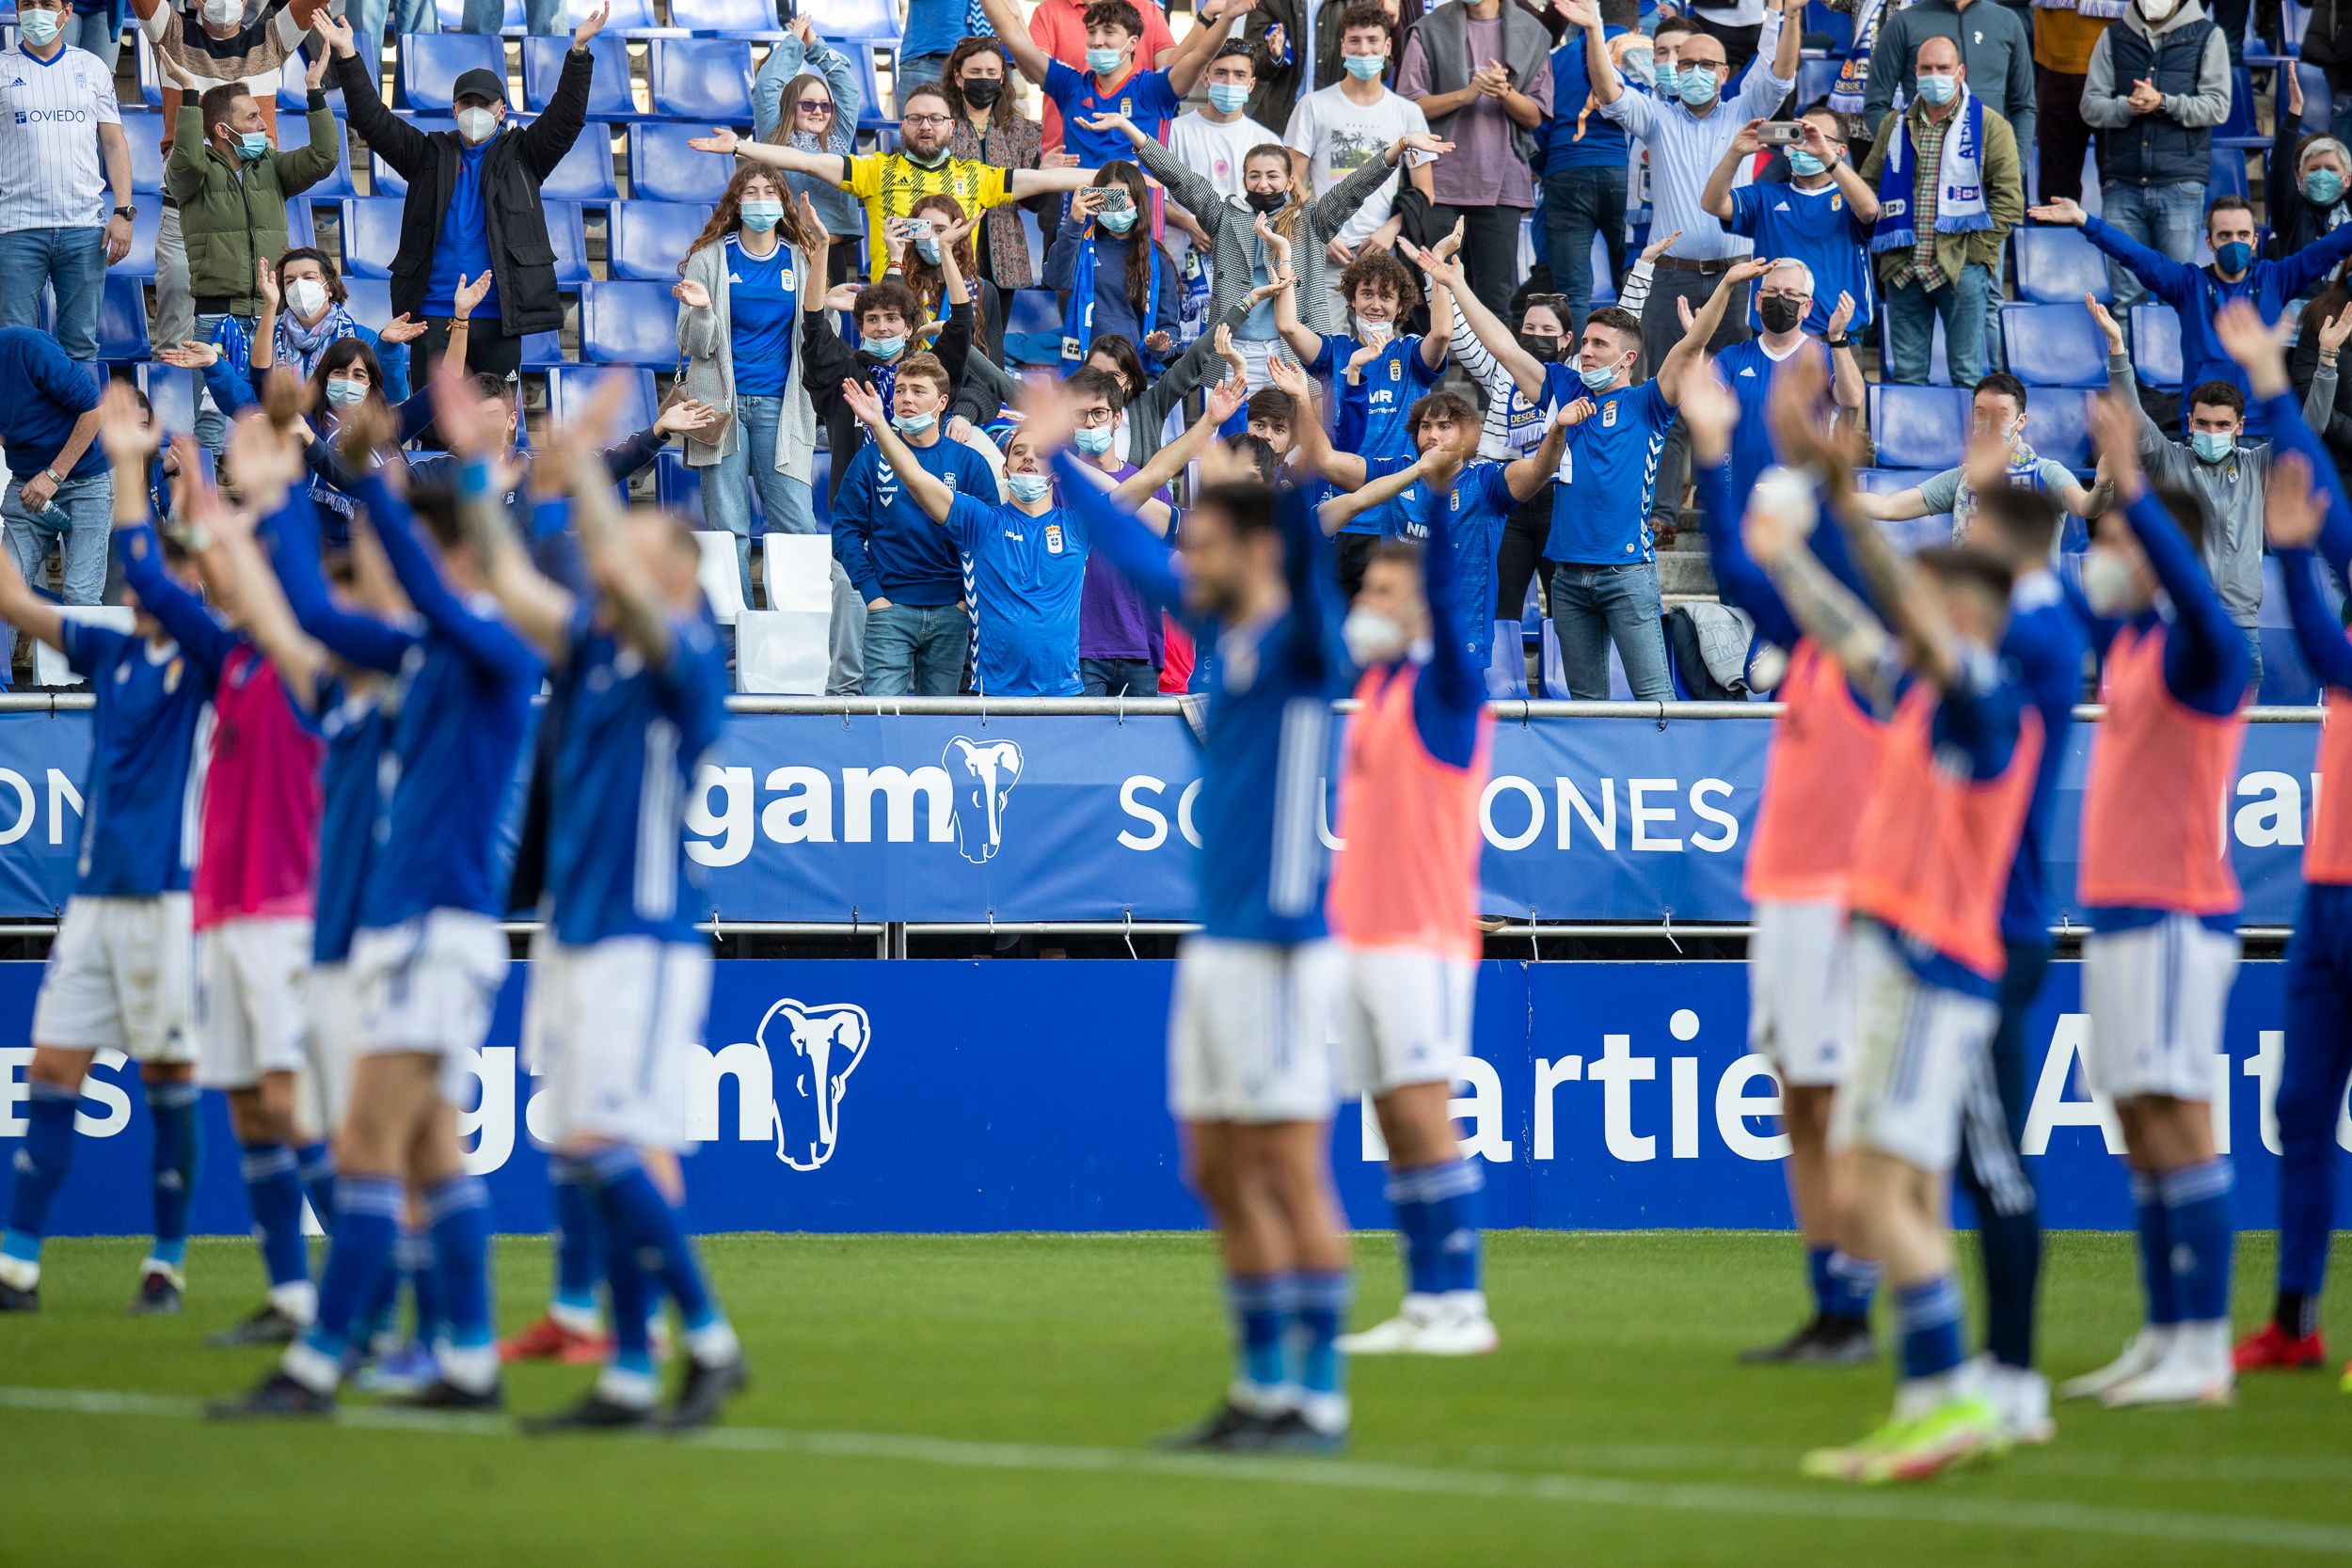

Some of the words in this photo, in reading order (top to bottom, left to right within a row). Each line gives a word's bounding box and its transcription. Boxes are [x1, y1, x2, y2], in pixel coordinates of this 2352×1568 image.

[29, 110, 86, 122] OVIEDO
[1368, 389, 1393, 404] MR
[1510, 409, 1536, 423] DESDE
[1406, 520, 1431, 539] NM
[683, 765, 955, 866] gam
[455, 1023, 773, 1176] gm
